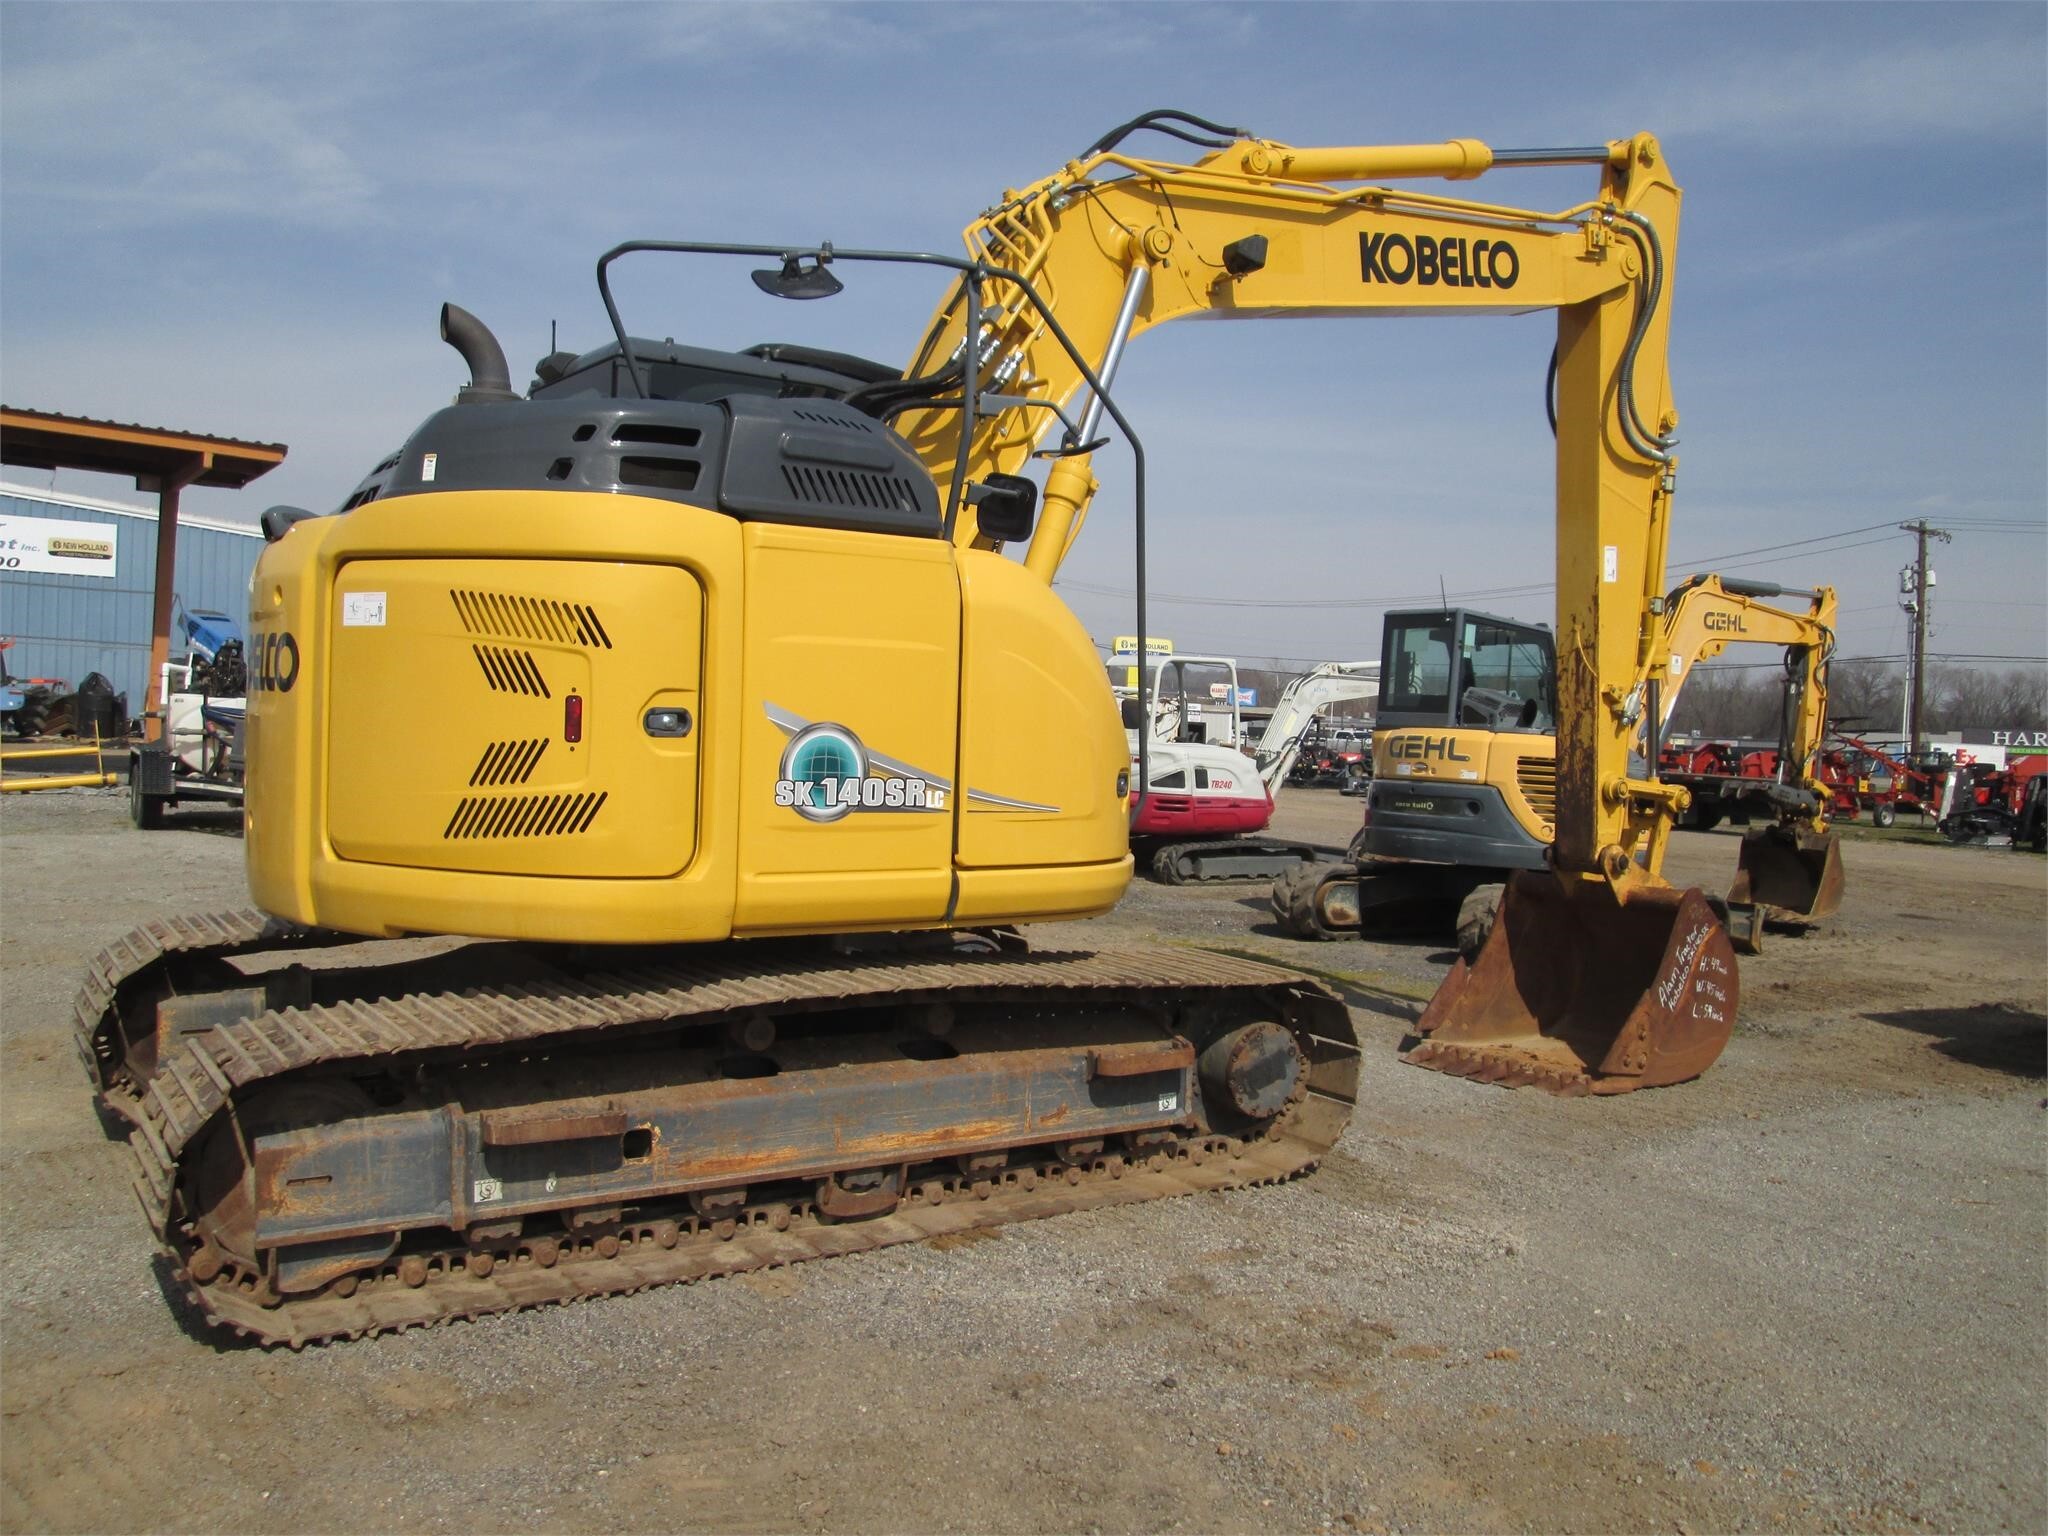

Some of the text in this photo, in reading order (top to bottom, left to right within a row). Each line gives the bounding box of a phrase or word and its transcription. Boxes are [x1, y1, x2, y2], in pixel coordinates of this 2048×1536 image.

[1359, 232, 1519, 289] KOBELCO
[78, 544, 109, 552] HOLLAND
[1703, 611, 1748, 632] GEHL
[1389, 735, 1471, 762] GEHL
[775, 779, 815, 807] SK
[1211, 780, 1233, 790] TB240
